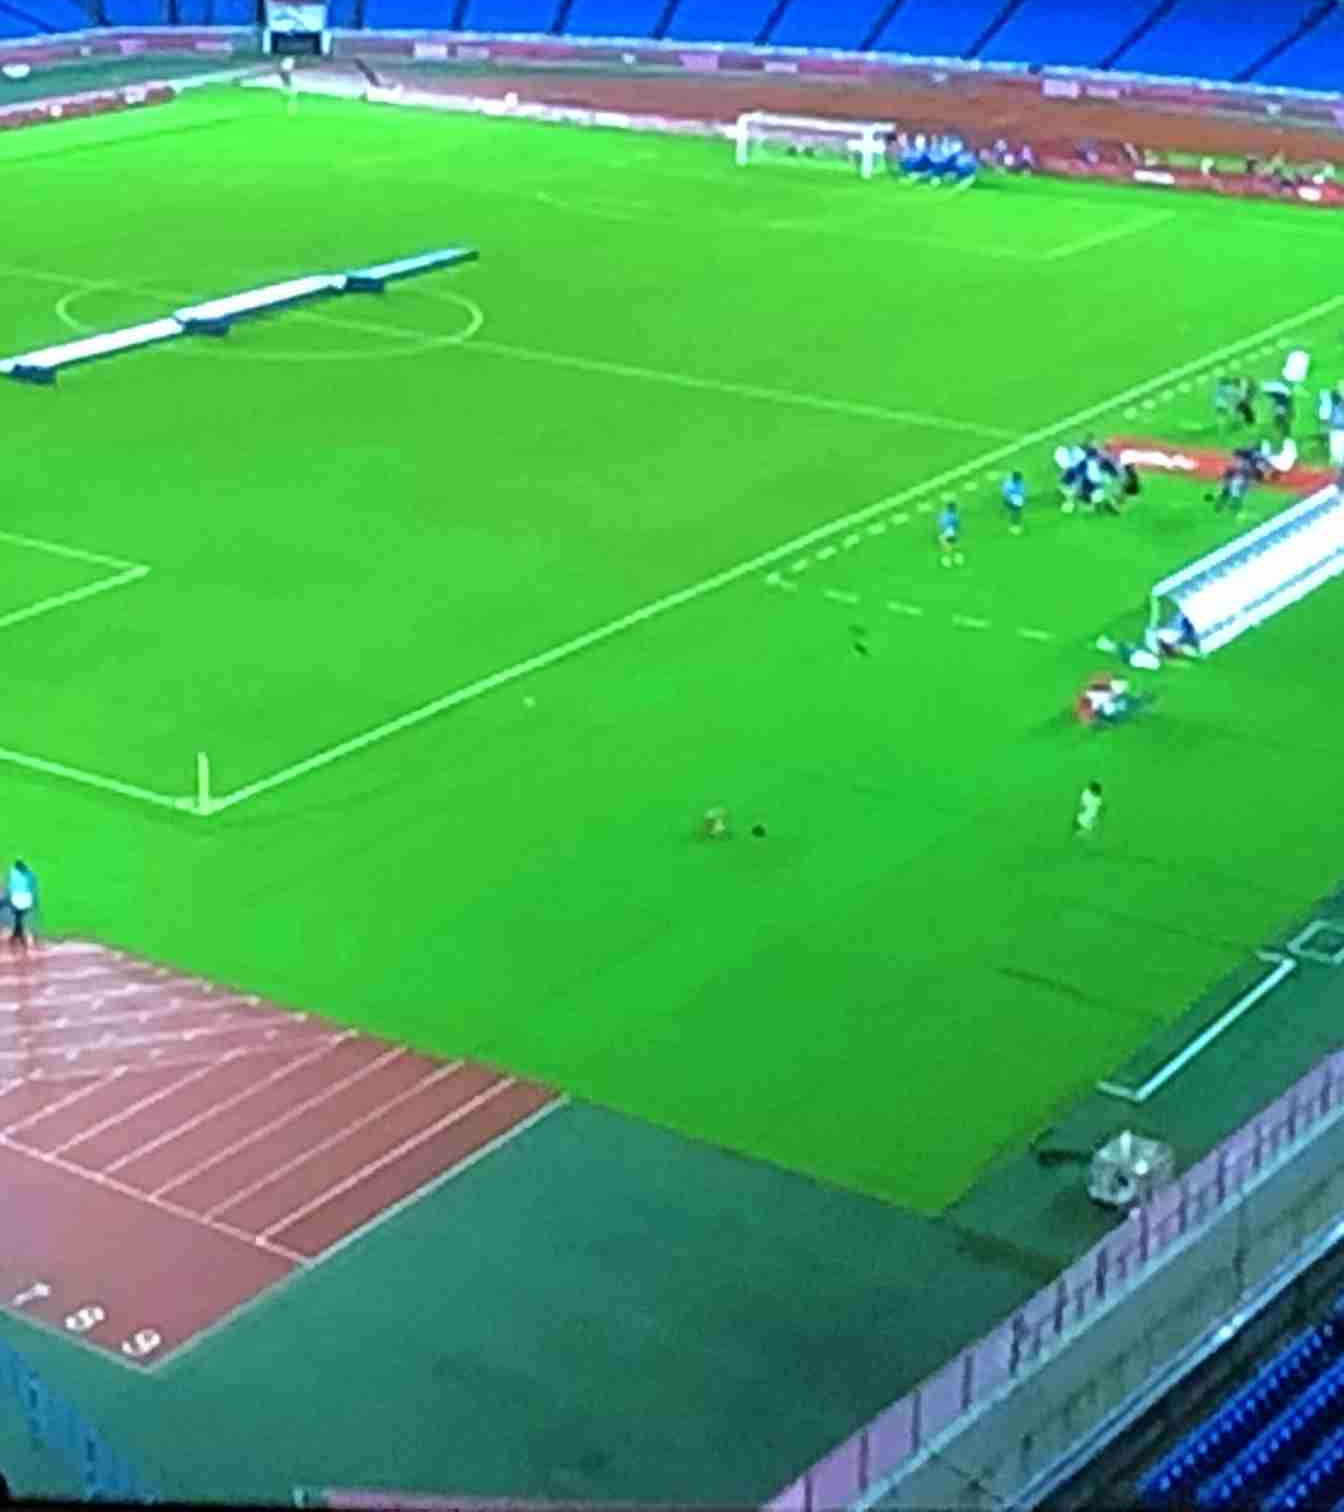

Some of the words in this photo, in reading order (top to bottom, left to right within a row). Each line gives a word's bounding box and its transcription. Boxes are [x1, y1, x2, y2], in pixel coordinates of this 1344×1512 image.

[12, 1282, 52, 1306] 7
[65, 1306, 106, 1332] 8
[121, 1329, 161, 1357] 9
